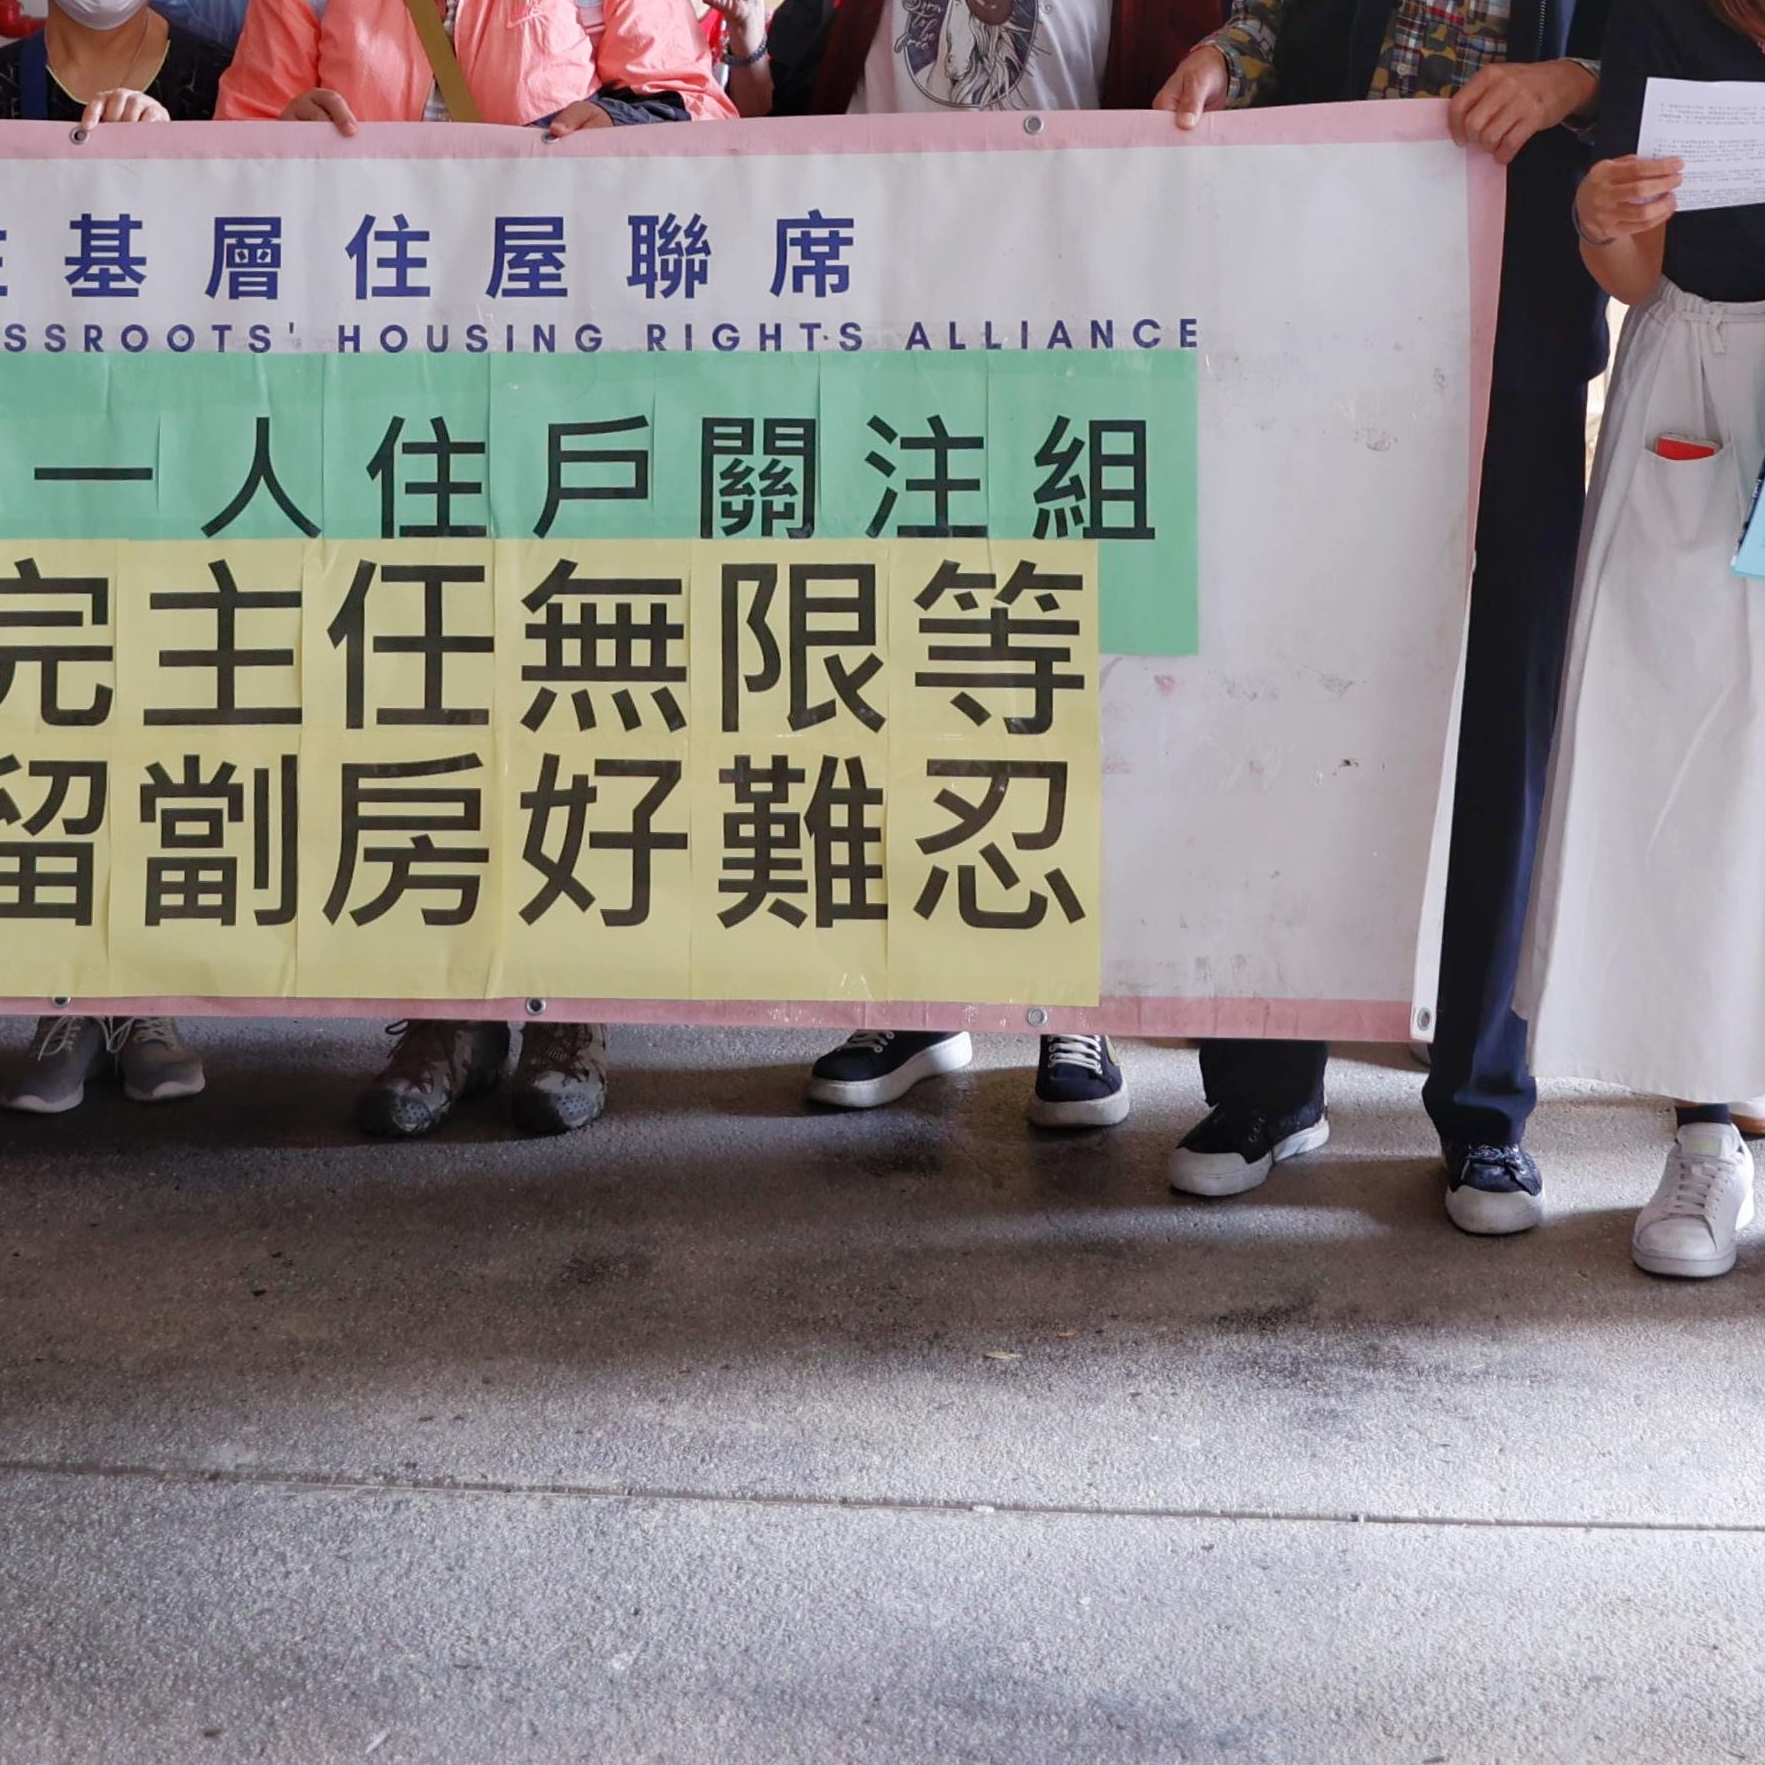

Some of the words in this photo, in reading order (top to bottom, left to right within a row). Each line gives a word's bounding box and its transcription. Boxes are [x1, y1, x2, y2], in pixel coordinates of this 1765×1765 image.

[338, 322, 604, 354] HOUSING
[647, 321, 865, 353] RIGHTS
[905, 317, 1198, 352] ALLIANCE
